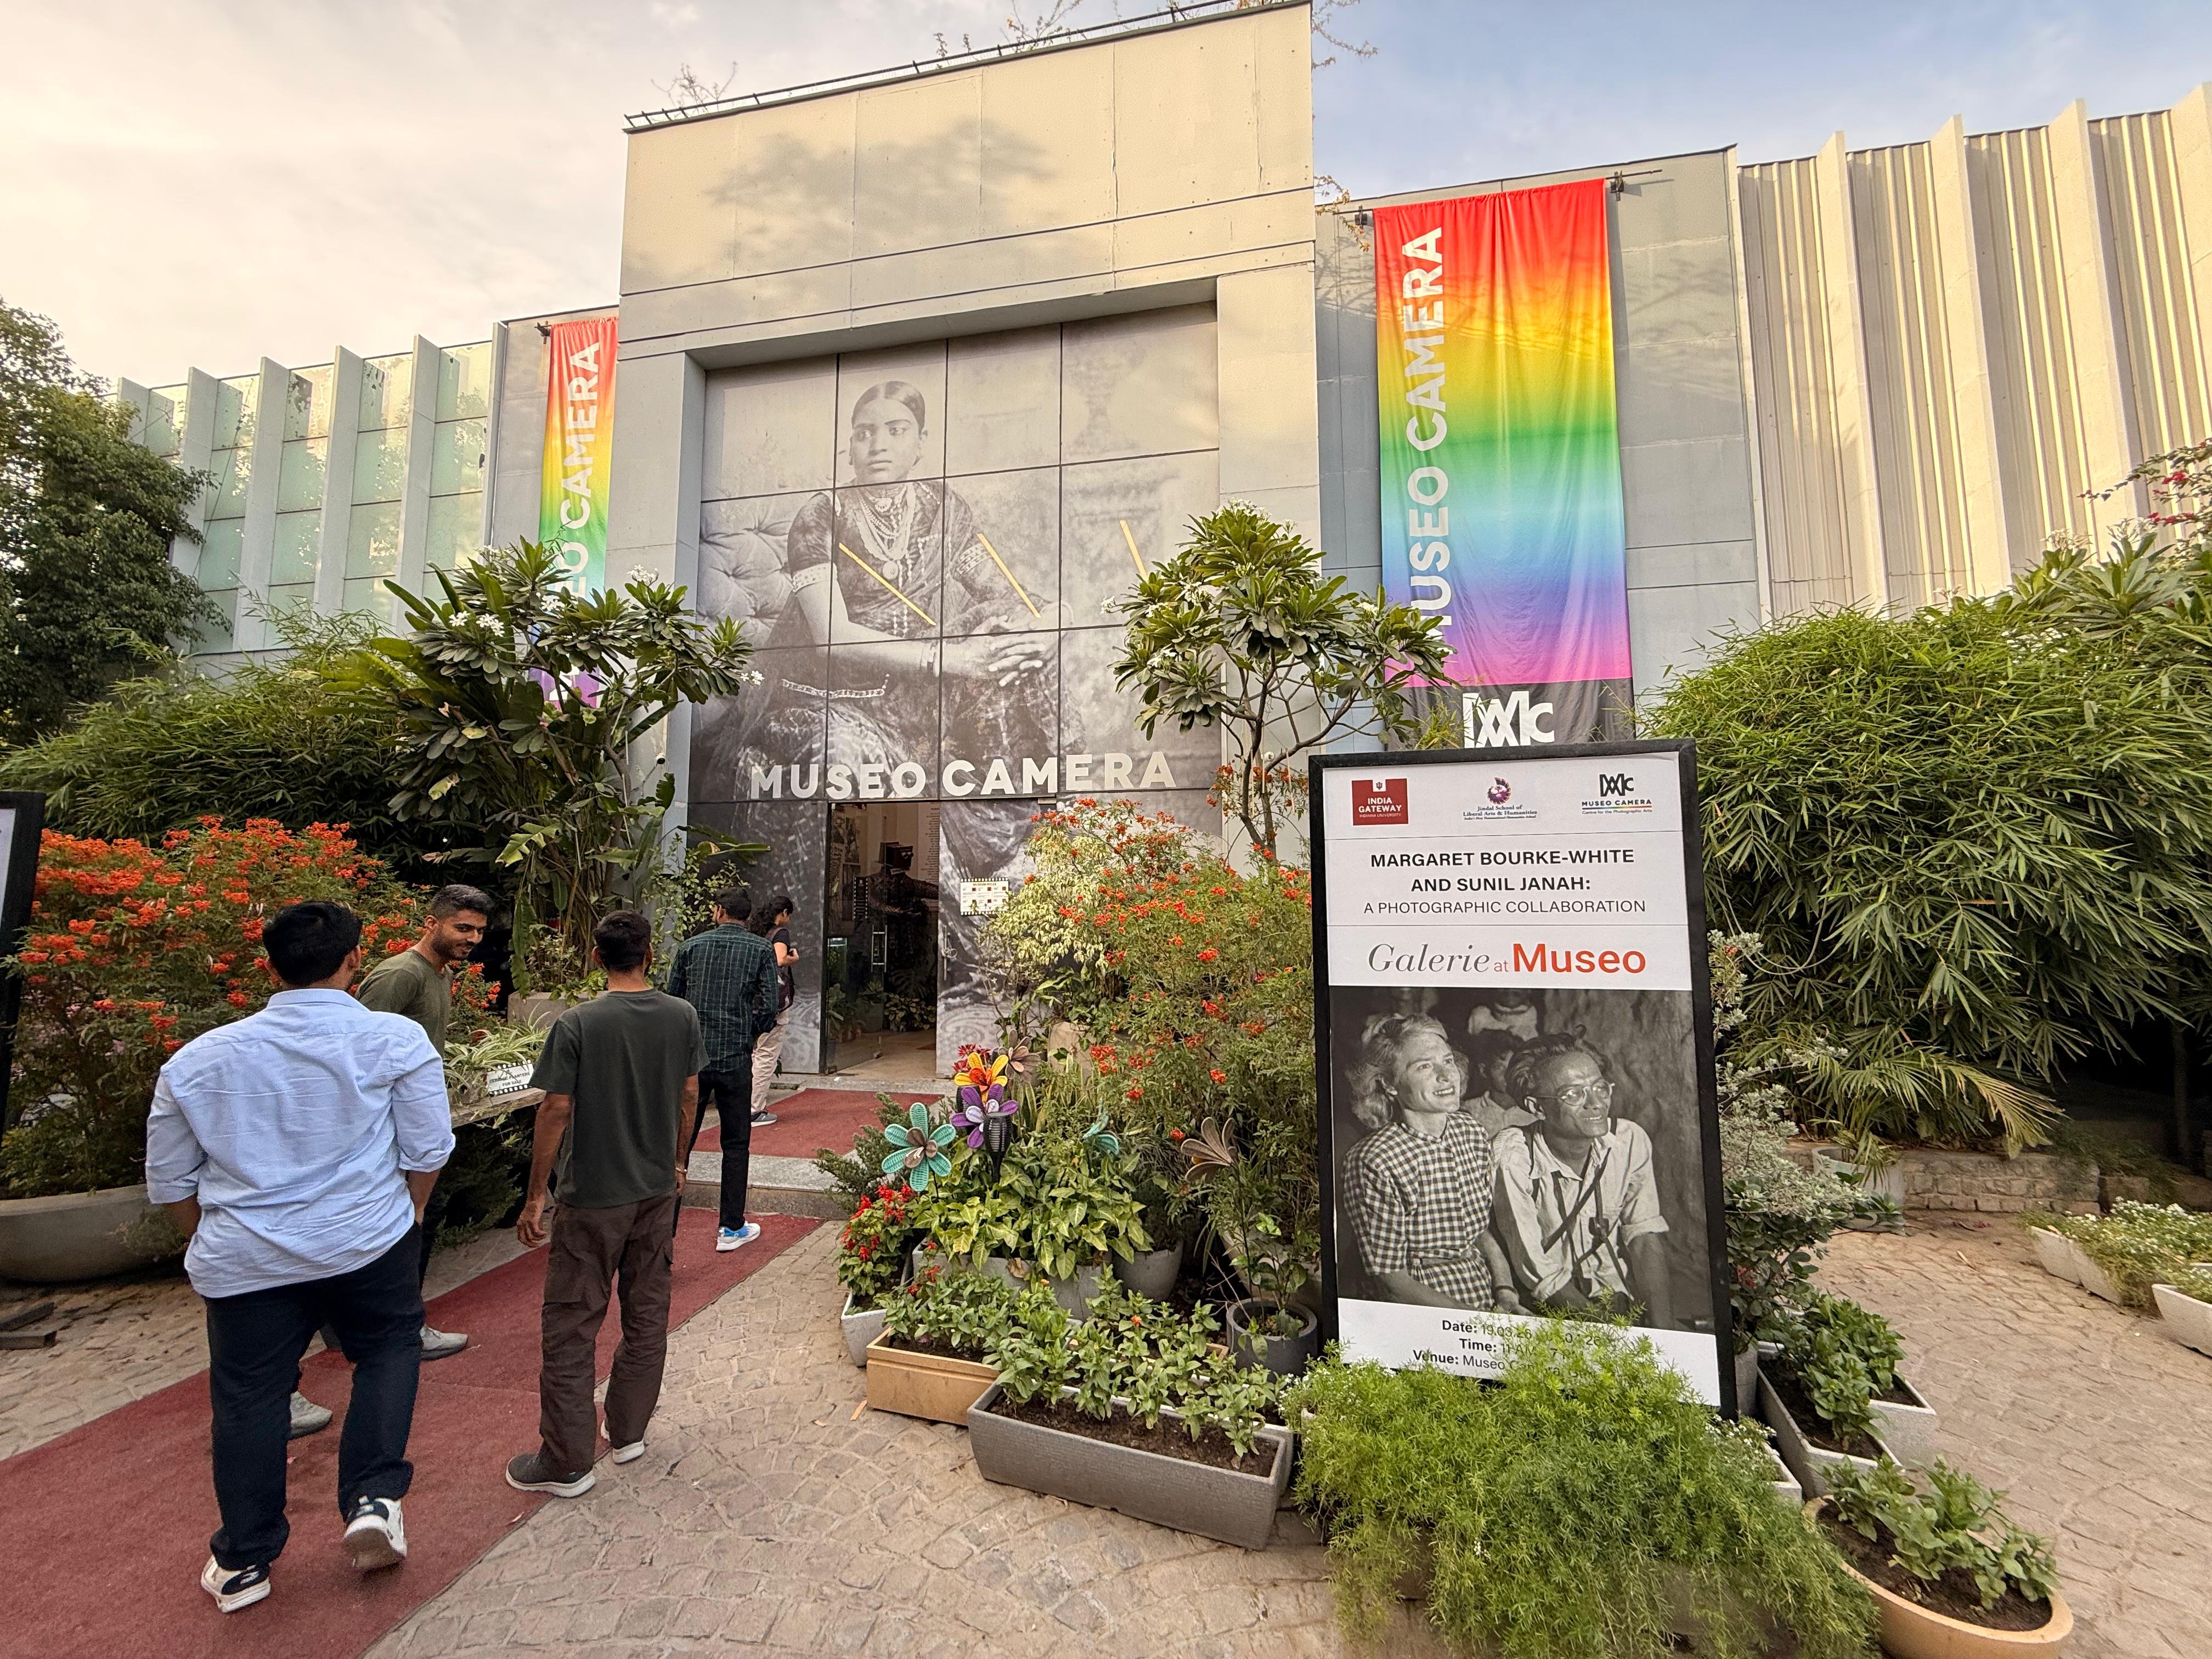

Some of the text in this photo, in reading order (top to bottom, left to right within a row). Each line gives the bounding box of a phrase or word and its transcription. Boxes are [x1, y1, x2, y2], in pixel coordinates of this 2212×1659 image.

[1402, 227, 1447, 451] CAMERA
[560, 342, 599, 529] CAMERA
[750, 751, 1177, 800] MUSEO CAMERA
[1358, 804, 1402, 813] GATEWAY
[1371, 849, 1634, 867] MARGARET BOURKE-WHITE
[1411, 877, 1590, 891] AND SUNIL JANAH:
[1364, 900, 1646, 913] A PHOTOGRAPHIC COLLABORATION
[1368, 943, 1646, 974] Galerie at Museo
[1442, 1319, 1477, 1334] Date:
[1459, 1338, 1497, 1352] Time:
[1413, 1350, 1459, 1365] Venue:
[1463, 1355, 1505, 1370] Museo
